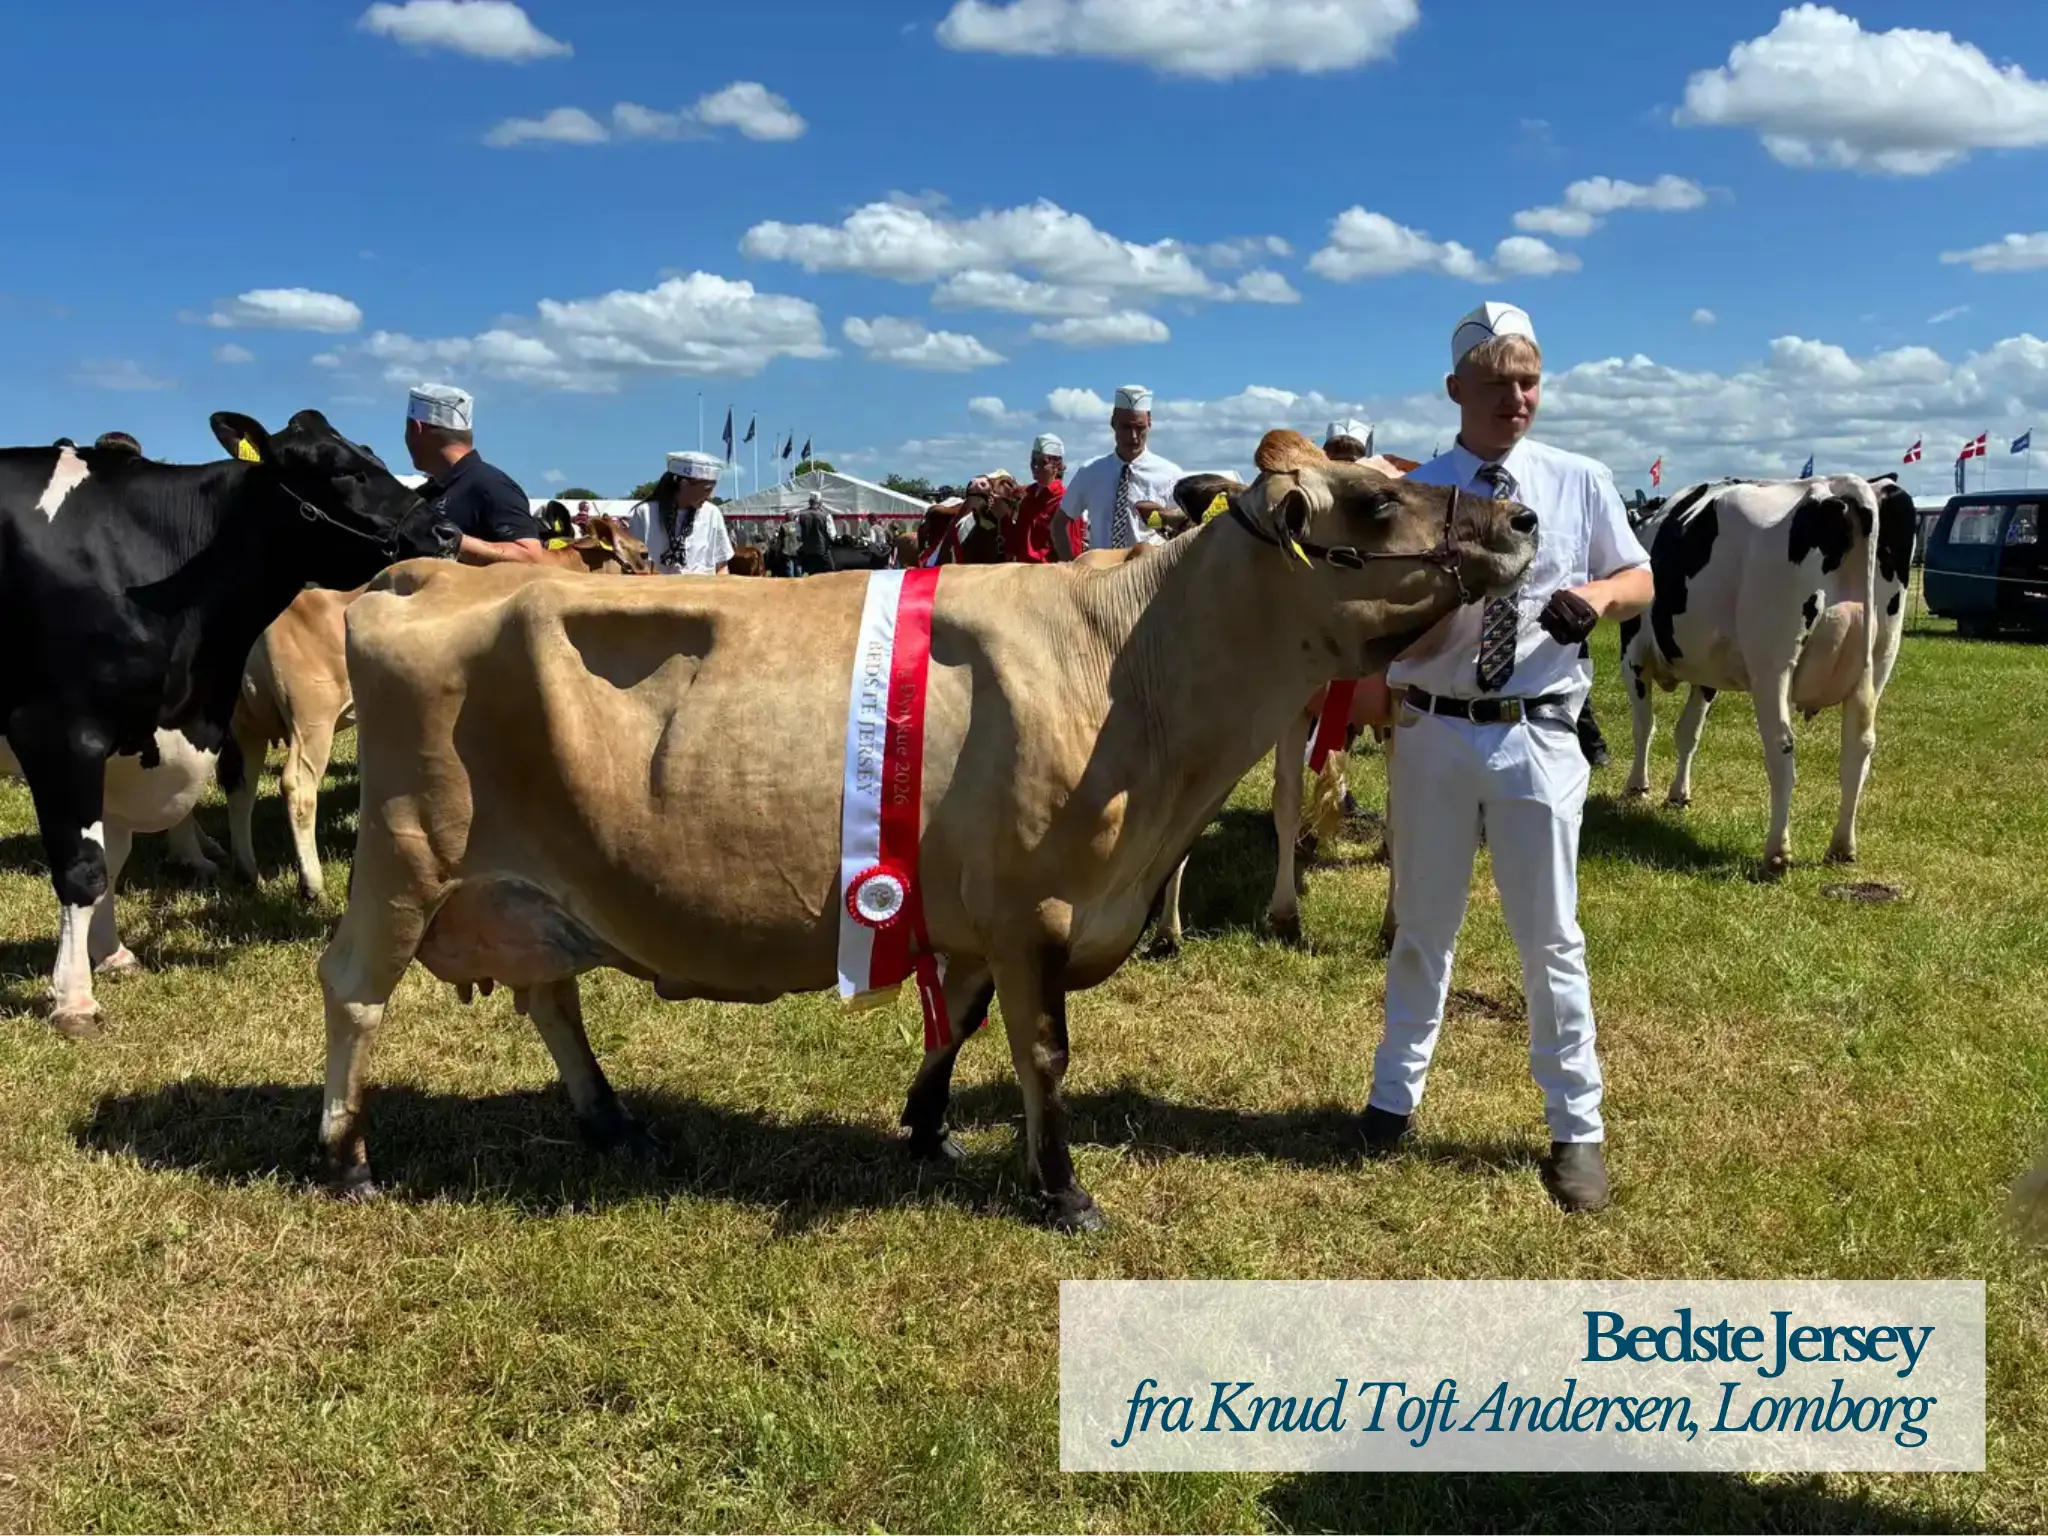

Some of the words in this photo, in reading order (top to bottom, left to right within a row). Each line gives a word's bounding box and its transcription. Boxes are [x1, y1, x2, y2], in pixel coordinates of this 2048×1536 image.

[861, 640, 884, 715] BEDSTE
[894, 684, 917, 756] Dyrkue
[856, 719, 877, 796] JERSEY
[893, 761, 911, 806] 2026
